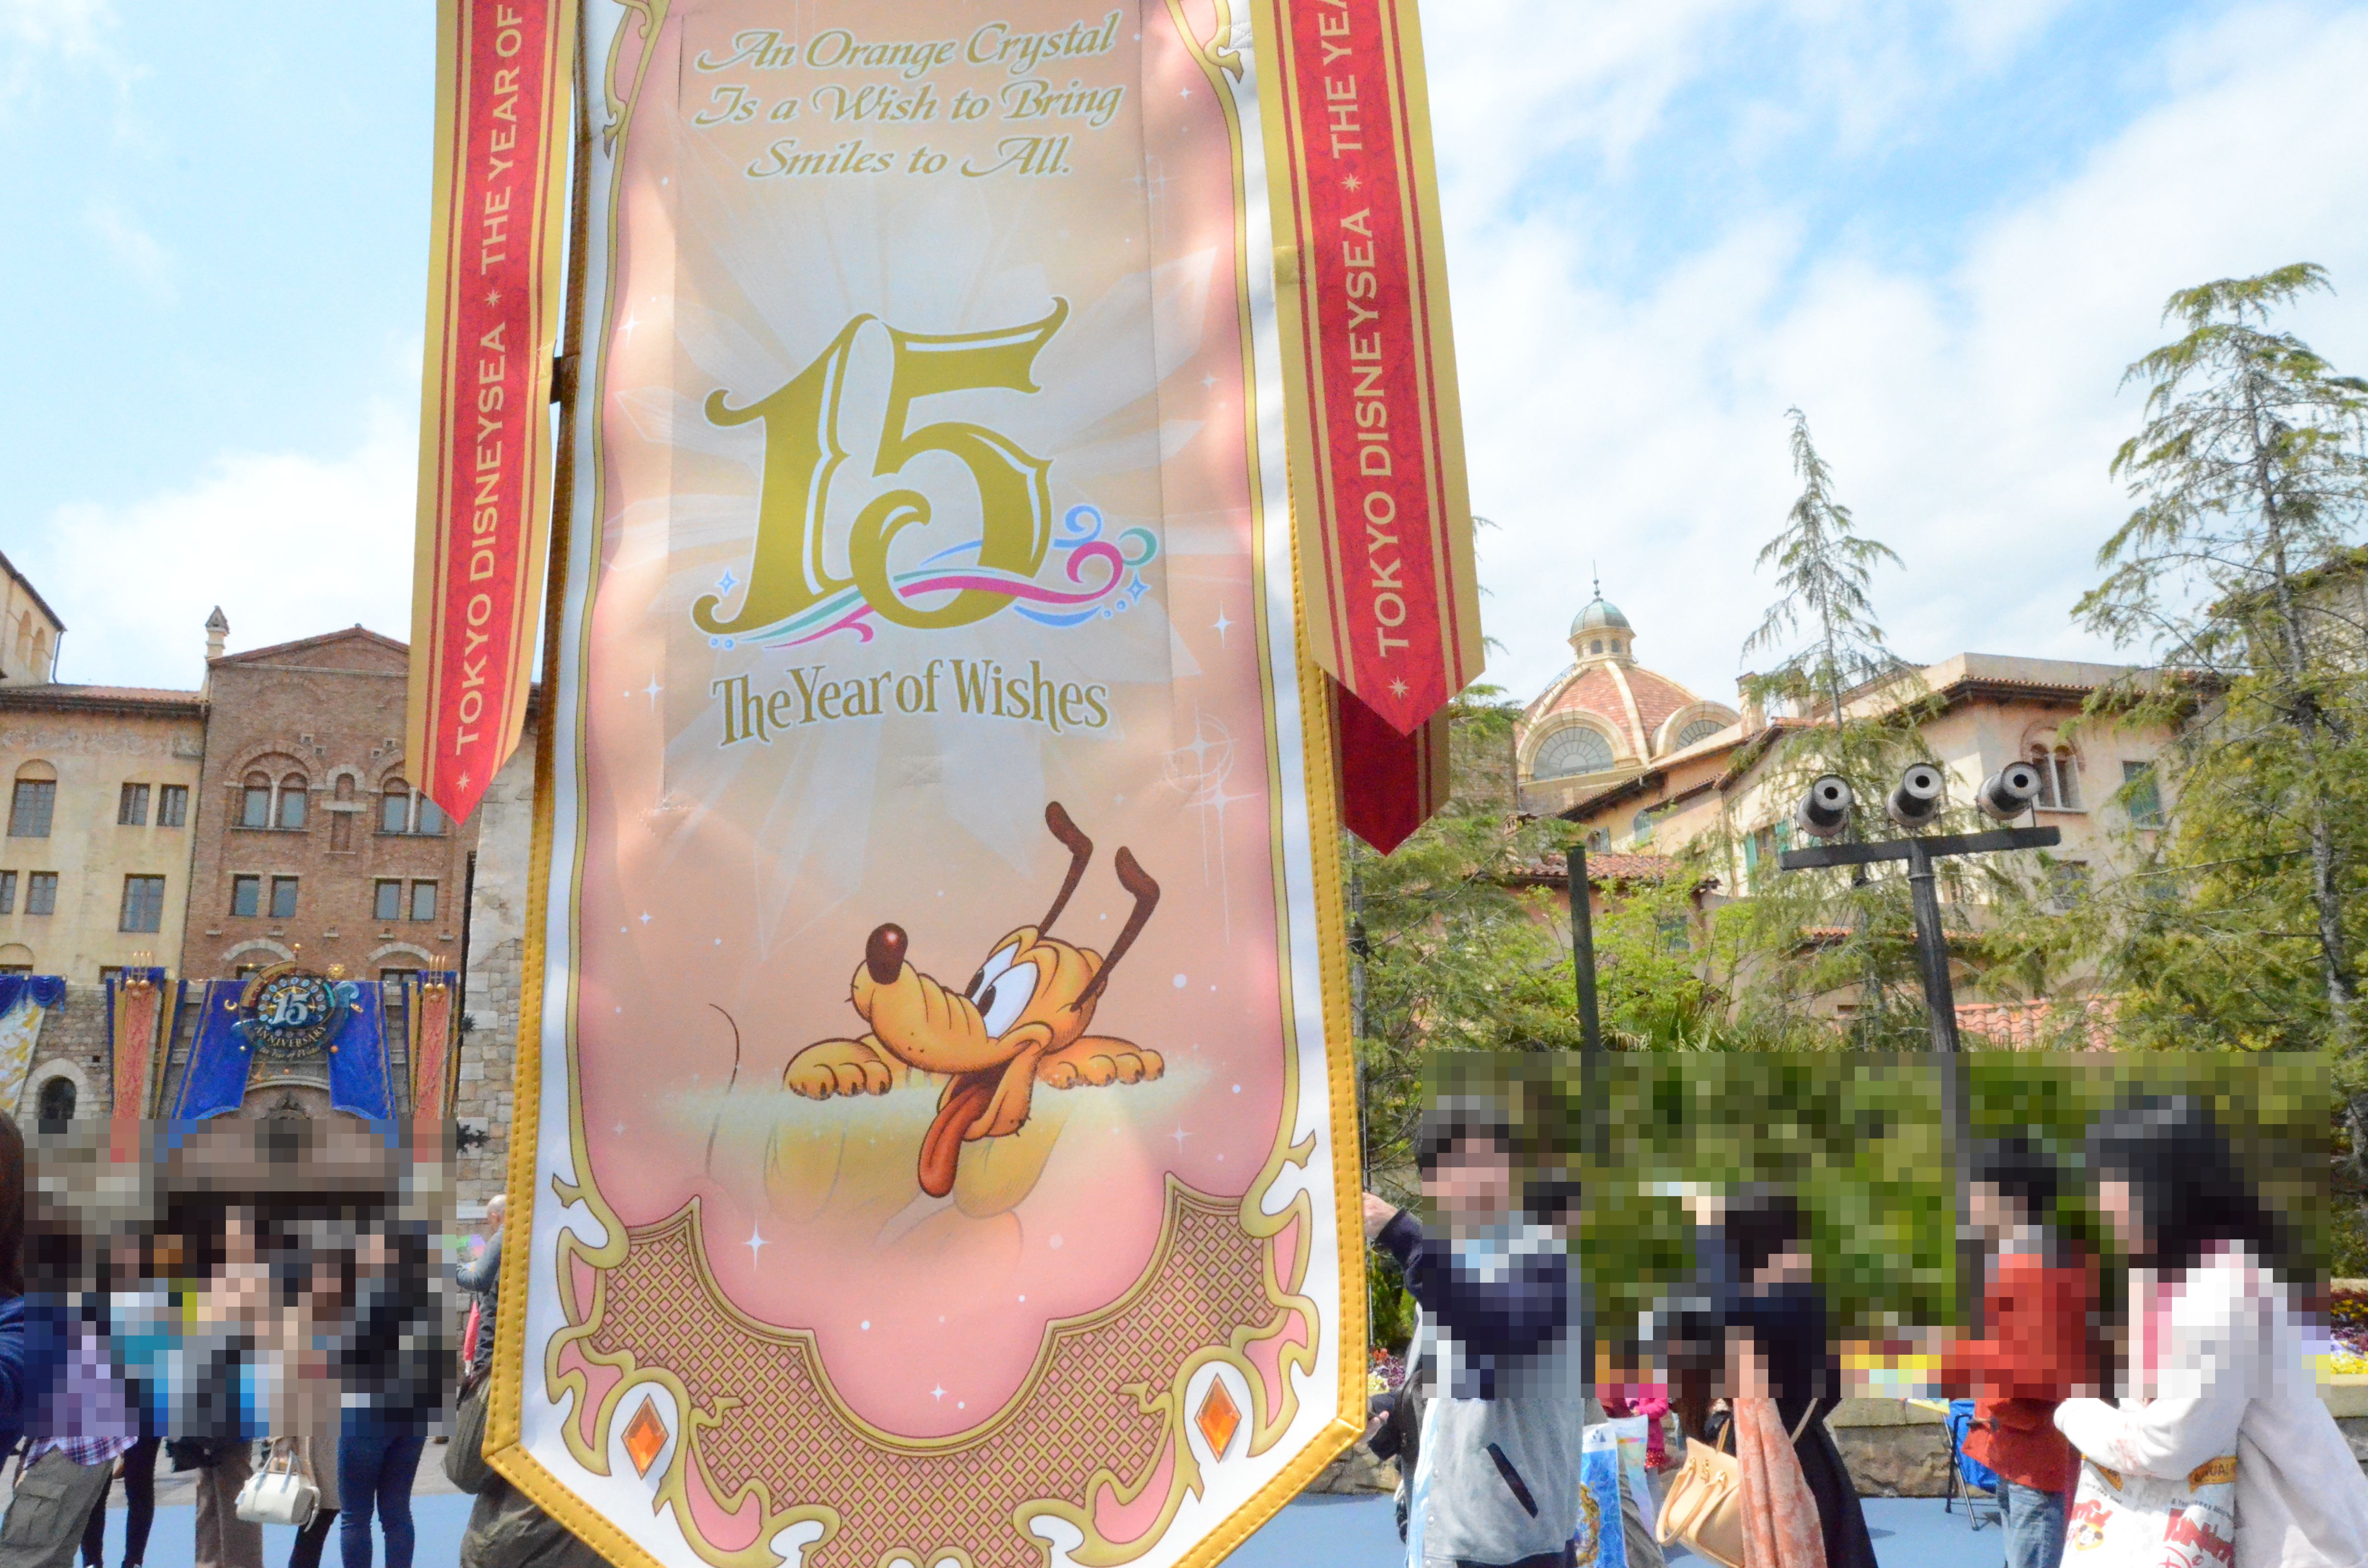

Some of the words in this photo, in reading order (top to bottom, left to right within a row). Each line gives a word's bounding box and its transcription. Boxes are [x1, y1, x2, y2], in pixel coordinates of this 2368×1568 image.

[495, 5, 522, 58] OF
[698, 31, 797, 70] An
[806, 31, 956, 79] Orange
[966, 11, 1122, 75] Crystal
[488, 67, 519, 180] YEAR
[695, 86, 758, 125] Is
[772, 100, 797, 122] a
[813, 84, 936, 121] Wish
[950, 91, 986, 121] to
[1000, 80, 1123, 127] Bring
[1325, 75, 1362, 158] THE
[748, 139, 892, 177] Smiles
[911, 146, 947, 175] to
[961, 135, 1072, 177] All.
[481, 187, 511, 274] THE
[1341, 208, 1392, 477] DISNEYSEA
[470, 323, 506, 581] DISNEYSEA
[692, 296, 1070, 634] 15
[1364, 491, 1409, 657] TOKYO
[456, 594, 492, 754] TOKYO
[712, 672, 791, 747] The
[789, 664, 892, 724] Year
[895, 658, 943, 713] of
[949, 658, 1109, 733] Wishes
[255, 1026, 326, 1048] ANNIVERSARY
[268, 992, 309, 1025] 15
